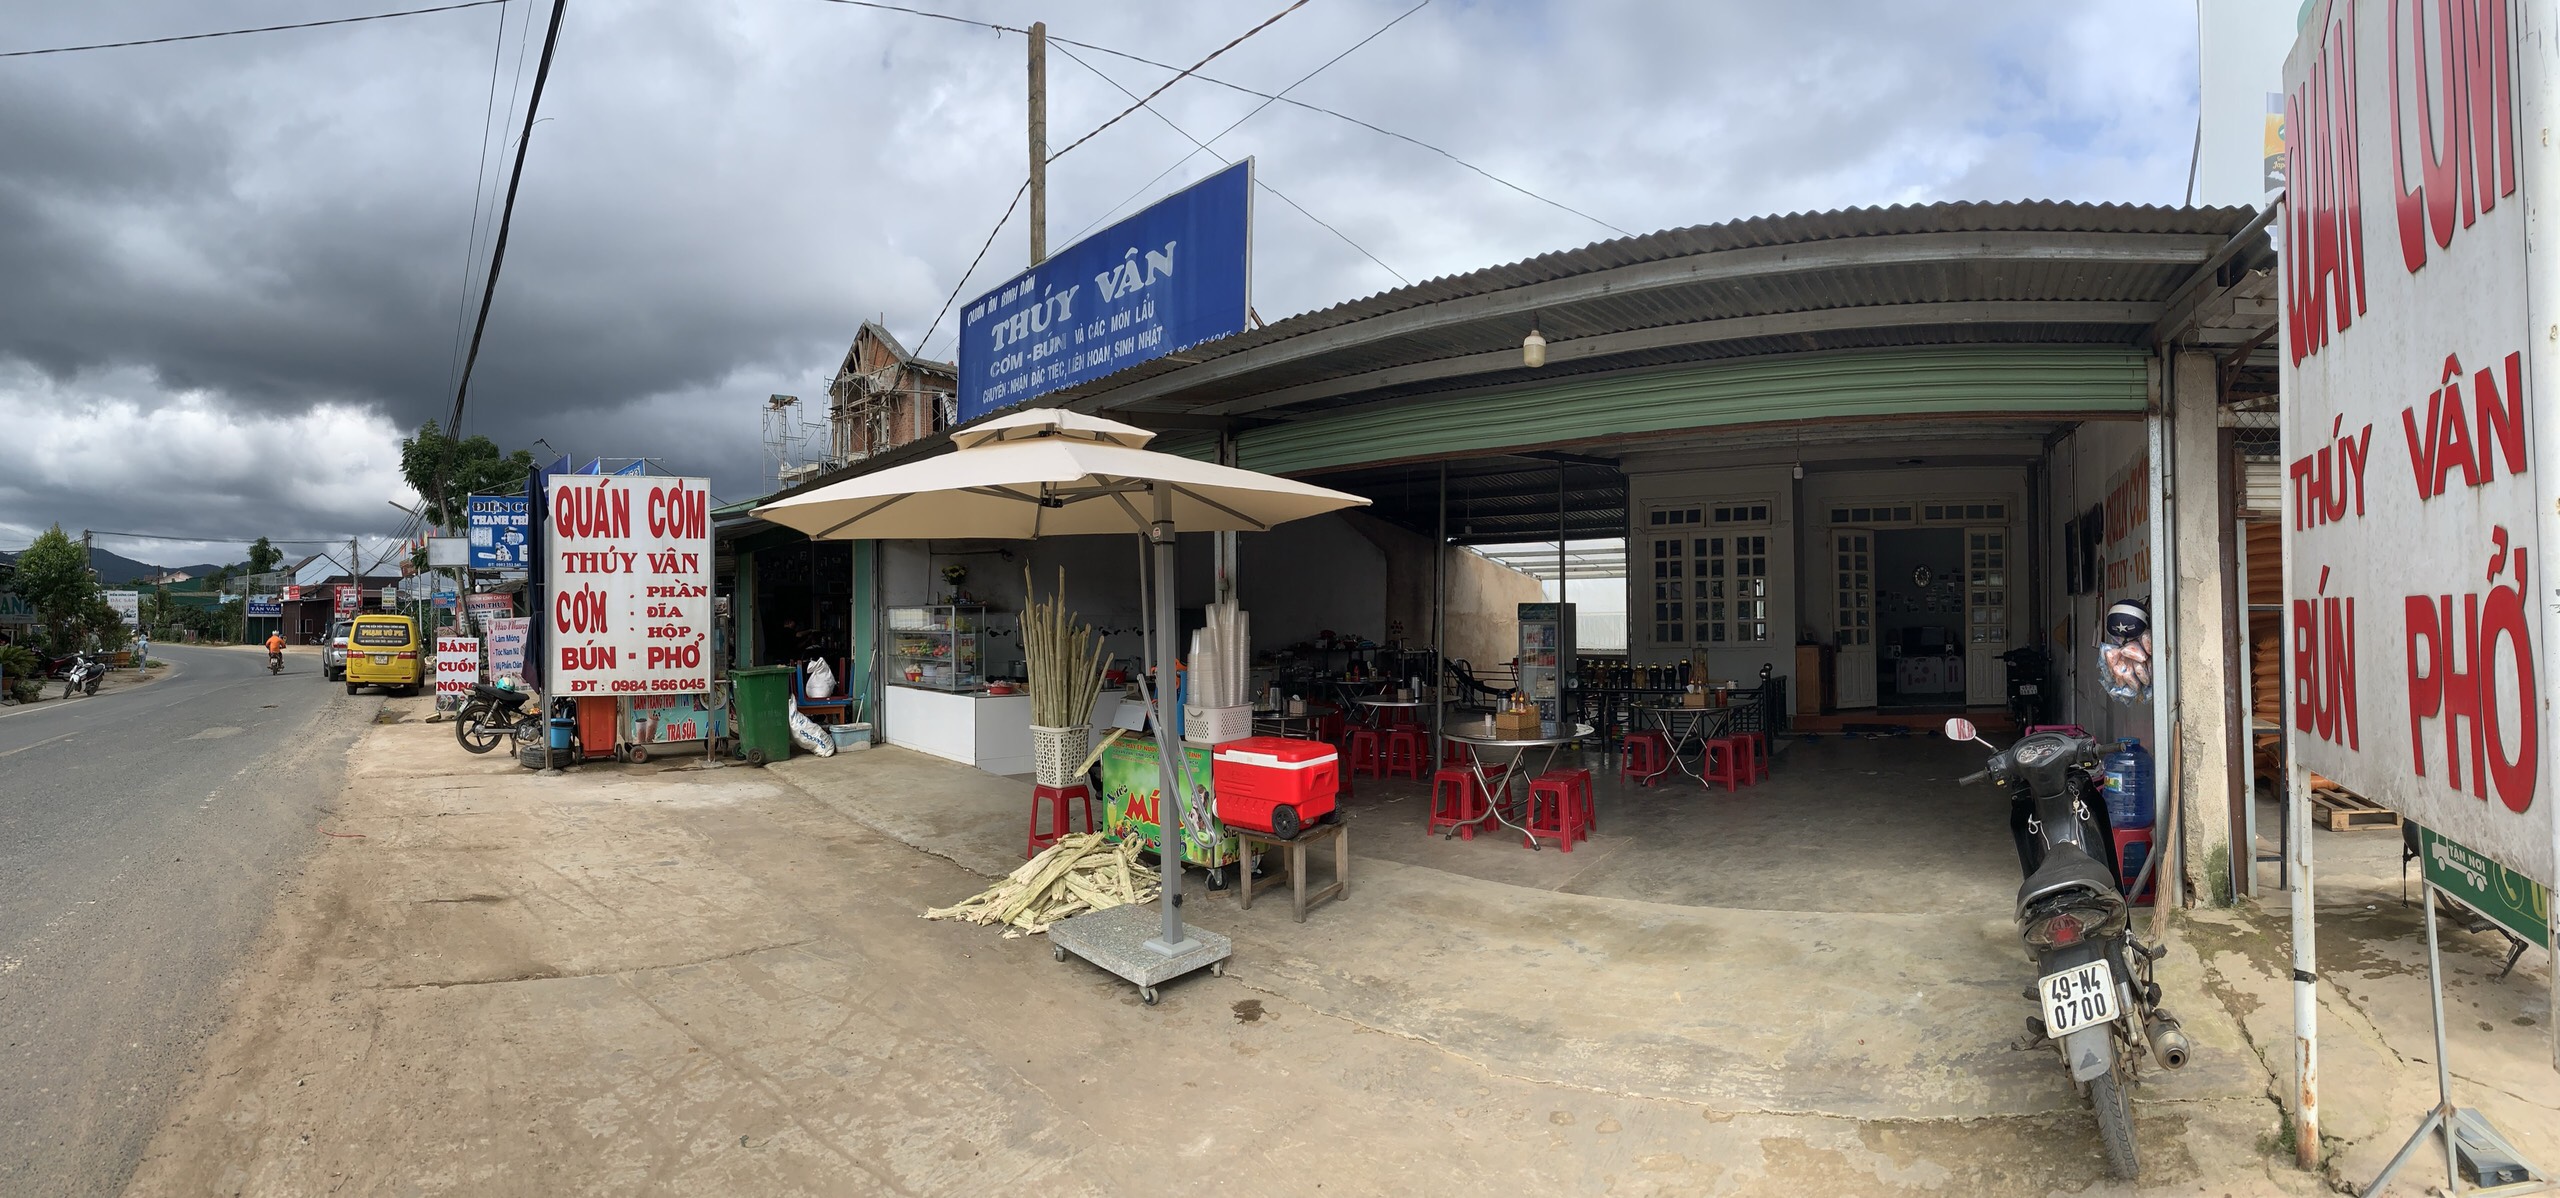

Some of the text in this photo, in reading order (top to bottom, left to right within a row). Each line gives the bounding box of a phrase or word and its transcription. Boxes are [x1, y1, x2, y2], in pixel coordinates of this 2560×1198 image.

[967, 274, 1037, 327] QUÁN ĂN BÌNH DÂN
[991, 240, 1177, 352] THÚY VÂN
[990, 352, 1023, 378] CƠM
[1074, 322, 1085, 345] VÀ
[1087, 315, 1106, 340] CÁC
[1110, 307, 1131, 333] MÓN
[1135, 292, 1155, 324] LẨU
[1010, 372, 1028, 395] NHẬN
[1031, 366, 1046, 389] ĐẶC
[1068, 351, 1085, 374] LIÊN
[1114, 336, 1135, 358] SINH
[1138, 323, 1163, 351] NHẬT
[2290, 352, 2527, 532] THÚY VÂN
[472, 500, 511, 514] ĐIỆN
[472, 515, 510, 525] THANH
[555, 477, 706, 542] QUÁN CƠM
[561, 545, 699, 574] THÚY VÂN
[2107, 552, 2129, 590] THÚY
[646, 578, 708, 597] PHẦN
[555, 581, 608, 634] CƠM
[646, 602, 684, 618] ĐĨA
[438, 640, 477, 653] BÁNH
[647, 623, 692, 641] HỘP
[438, 658, 477, 672] CUỐN
[561, 633, 705, 671] BÚN PHỞ
[2294, 525, 2538, 814] BÚN PHỞ
[611, 680, 648, 692] 0984
[651, 679, 677, 691] 566
[679, 678, 706, 690] 045
[667, 719, 681, 741] TRÀ
[682, 718, 697, 740] SỮA
[2448, 844, 2486, 874] TẬN NƠI
[2051, 966, 2101, 1003] 49-N4
[2055, 992, 2107, 1030] 0700
